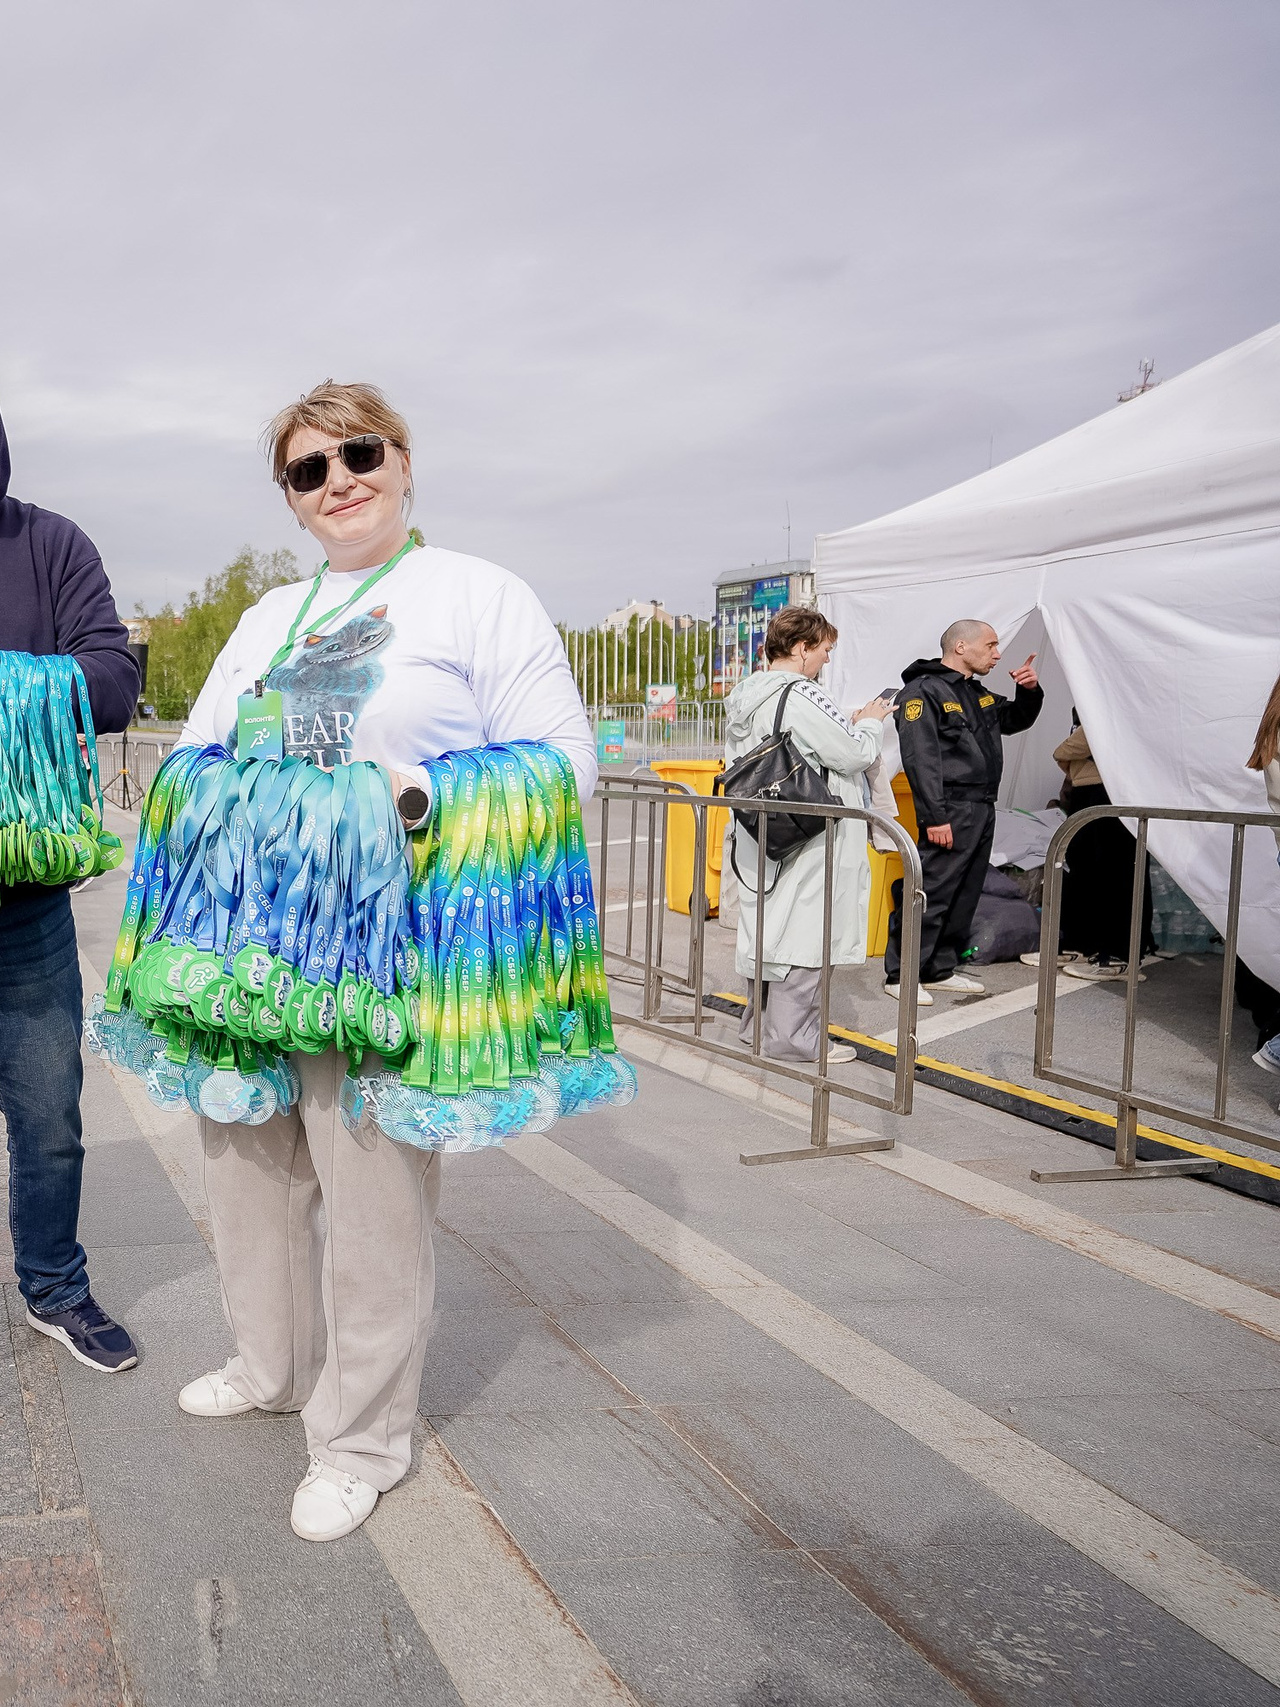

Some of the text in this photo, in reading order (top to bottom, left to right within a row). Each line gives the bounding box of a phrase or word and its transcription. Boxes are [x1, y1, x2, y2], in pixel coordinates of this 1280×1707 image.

[244, 714, 276, 725] ВОЛОНТЁР
[520, 750, 535, 768] СБЕР
[507, 771, 518, 793] СБЕР
[542, 762, 552, 784] СБЕР
[445, 783, 454, 806] СБЕР
[465, 780, 474, 802] СБЕР
[535, 804, 543, 818] 185
[129, 895, 139, 915] СБЕР
[152, 888, 162, 909] СБЕР
[184, 909, 194, 934] СБЕР
[286, 906, 298, 934] СБЕР
[576, 918, 584, 939] СБЕР
[232, 926, 240, 953] СБЕР
[331, 926, 344, 954] СБЕР
[589, 930, 598, 951] СБЕР
[475, 960, 483, 983] СБЕР
[507, 956, 516, 980] СБЕР
